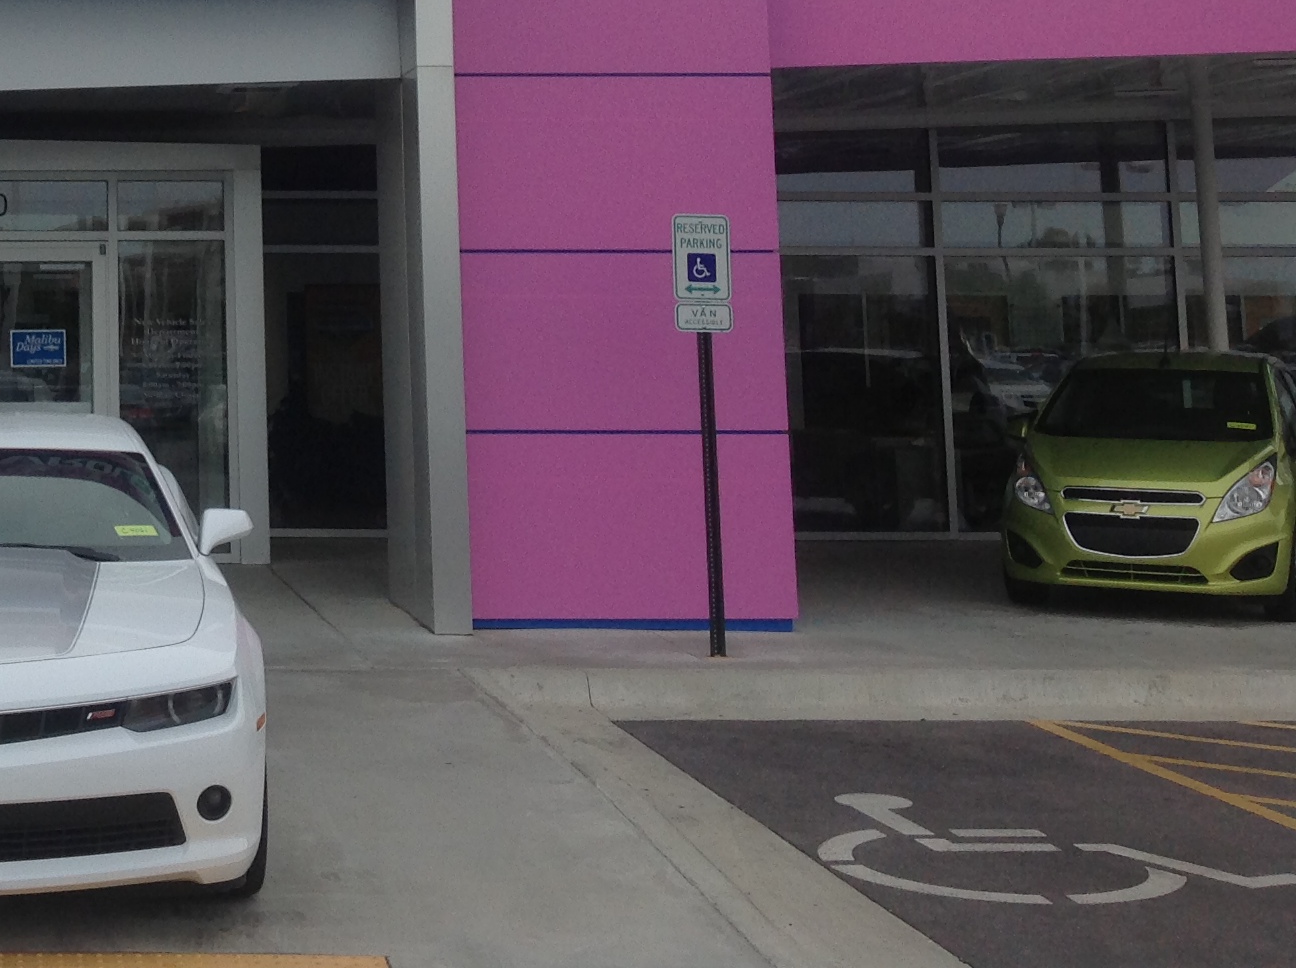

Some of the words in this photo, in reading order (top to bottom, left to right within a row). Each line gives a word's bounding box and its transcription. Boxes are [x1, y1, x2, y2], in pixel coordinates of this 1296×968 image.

[676, 222, 725, 235] RESERVED
[680, 237, 722, 249] PARKING
[691, 309, 717, 318] VAN
[24, 333, 61, 344] Malibu
[16, 341, 41, 354] Days
